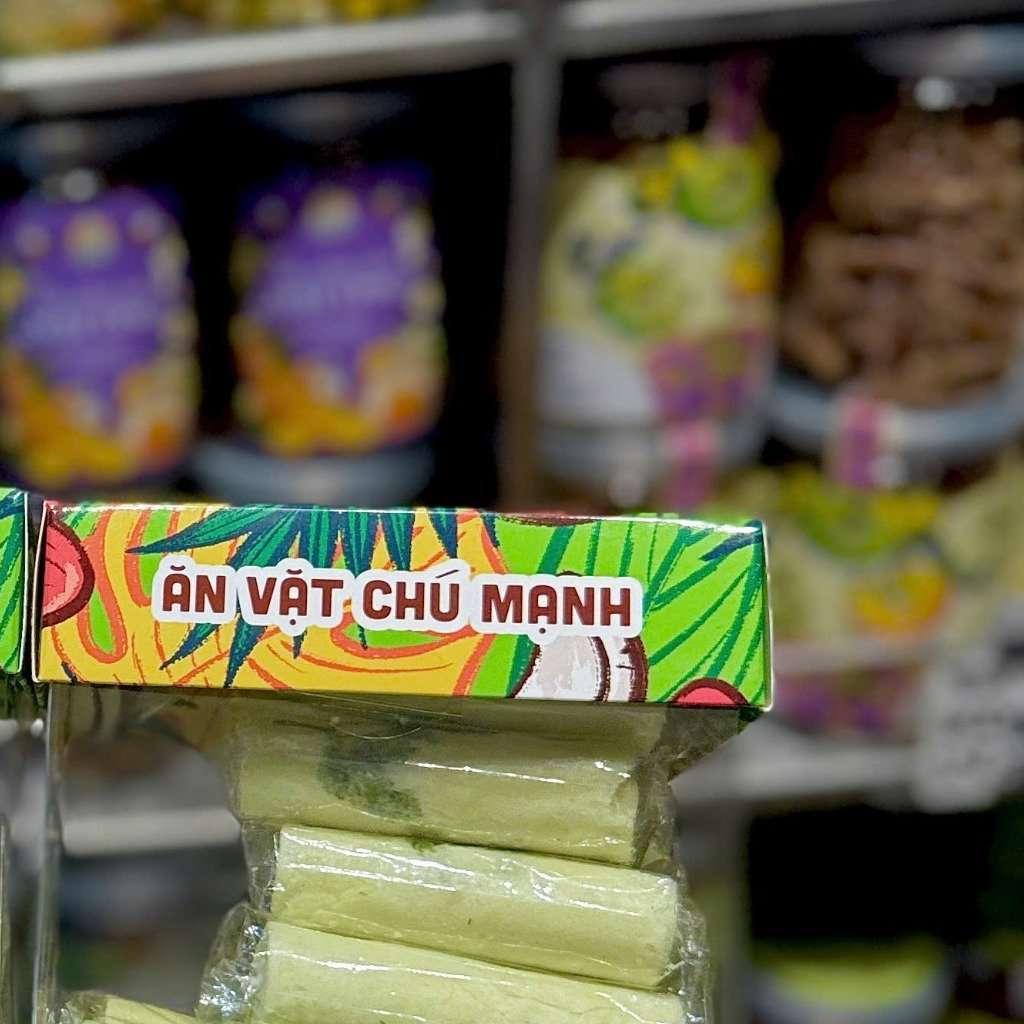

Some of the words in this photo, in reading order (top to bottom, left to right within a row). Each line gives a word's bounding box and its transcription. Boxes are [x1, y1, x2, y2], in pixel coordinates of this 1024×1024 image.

[162, 564, 226, 613] ĂN
[246, 568, 344, 626] VẶT
[362, 569, 460, 622] CHÚ
[481, 584, 631, 634] MẠNH
